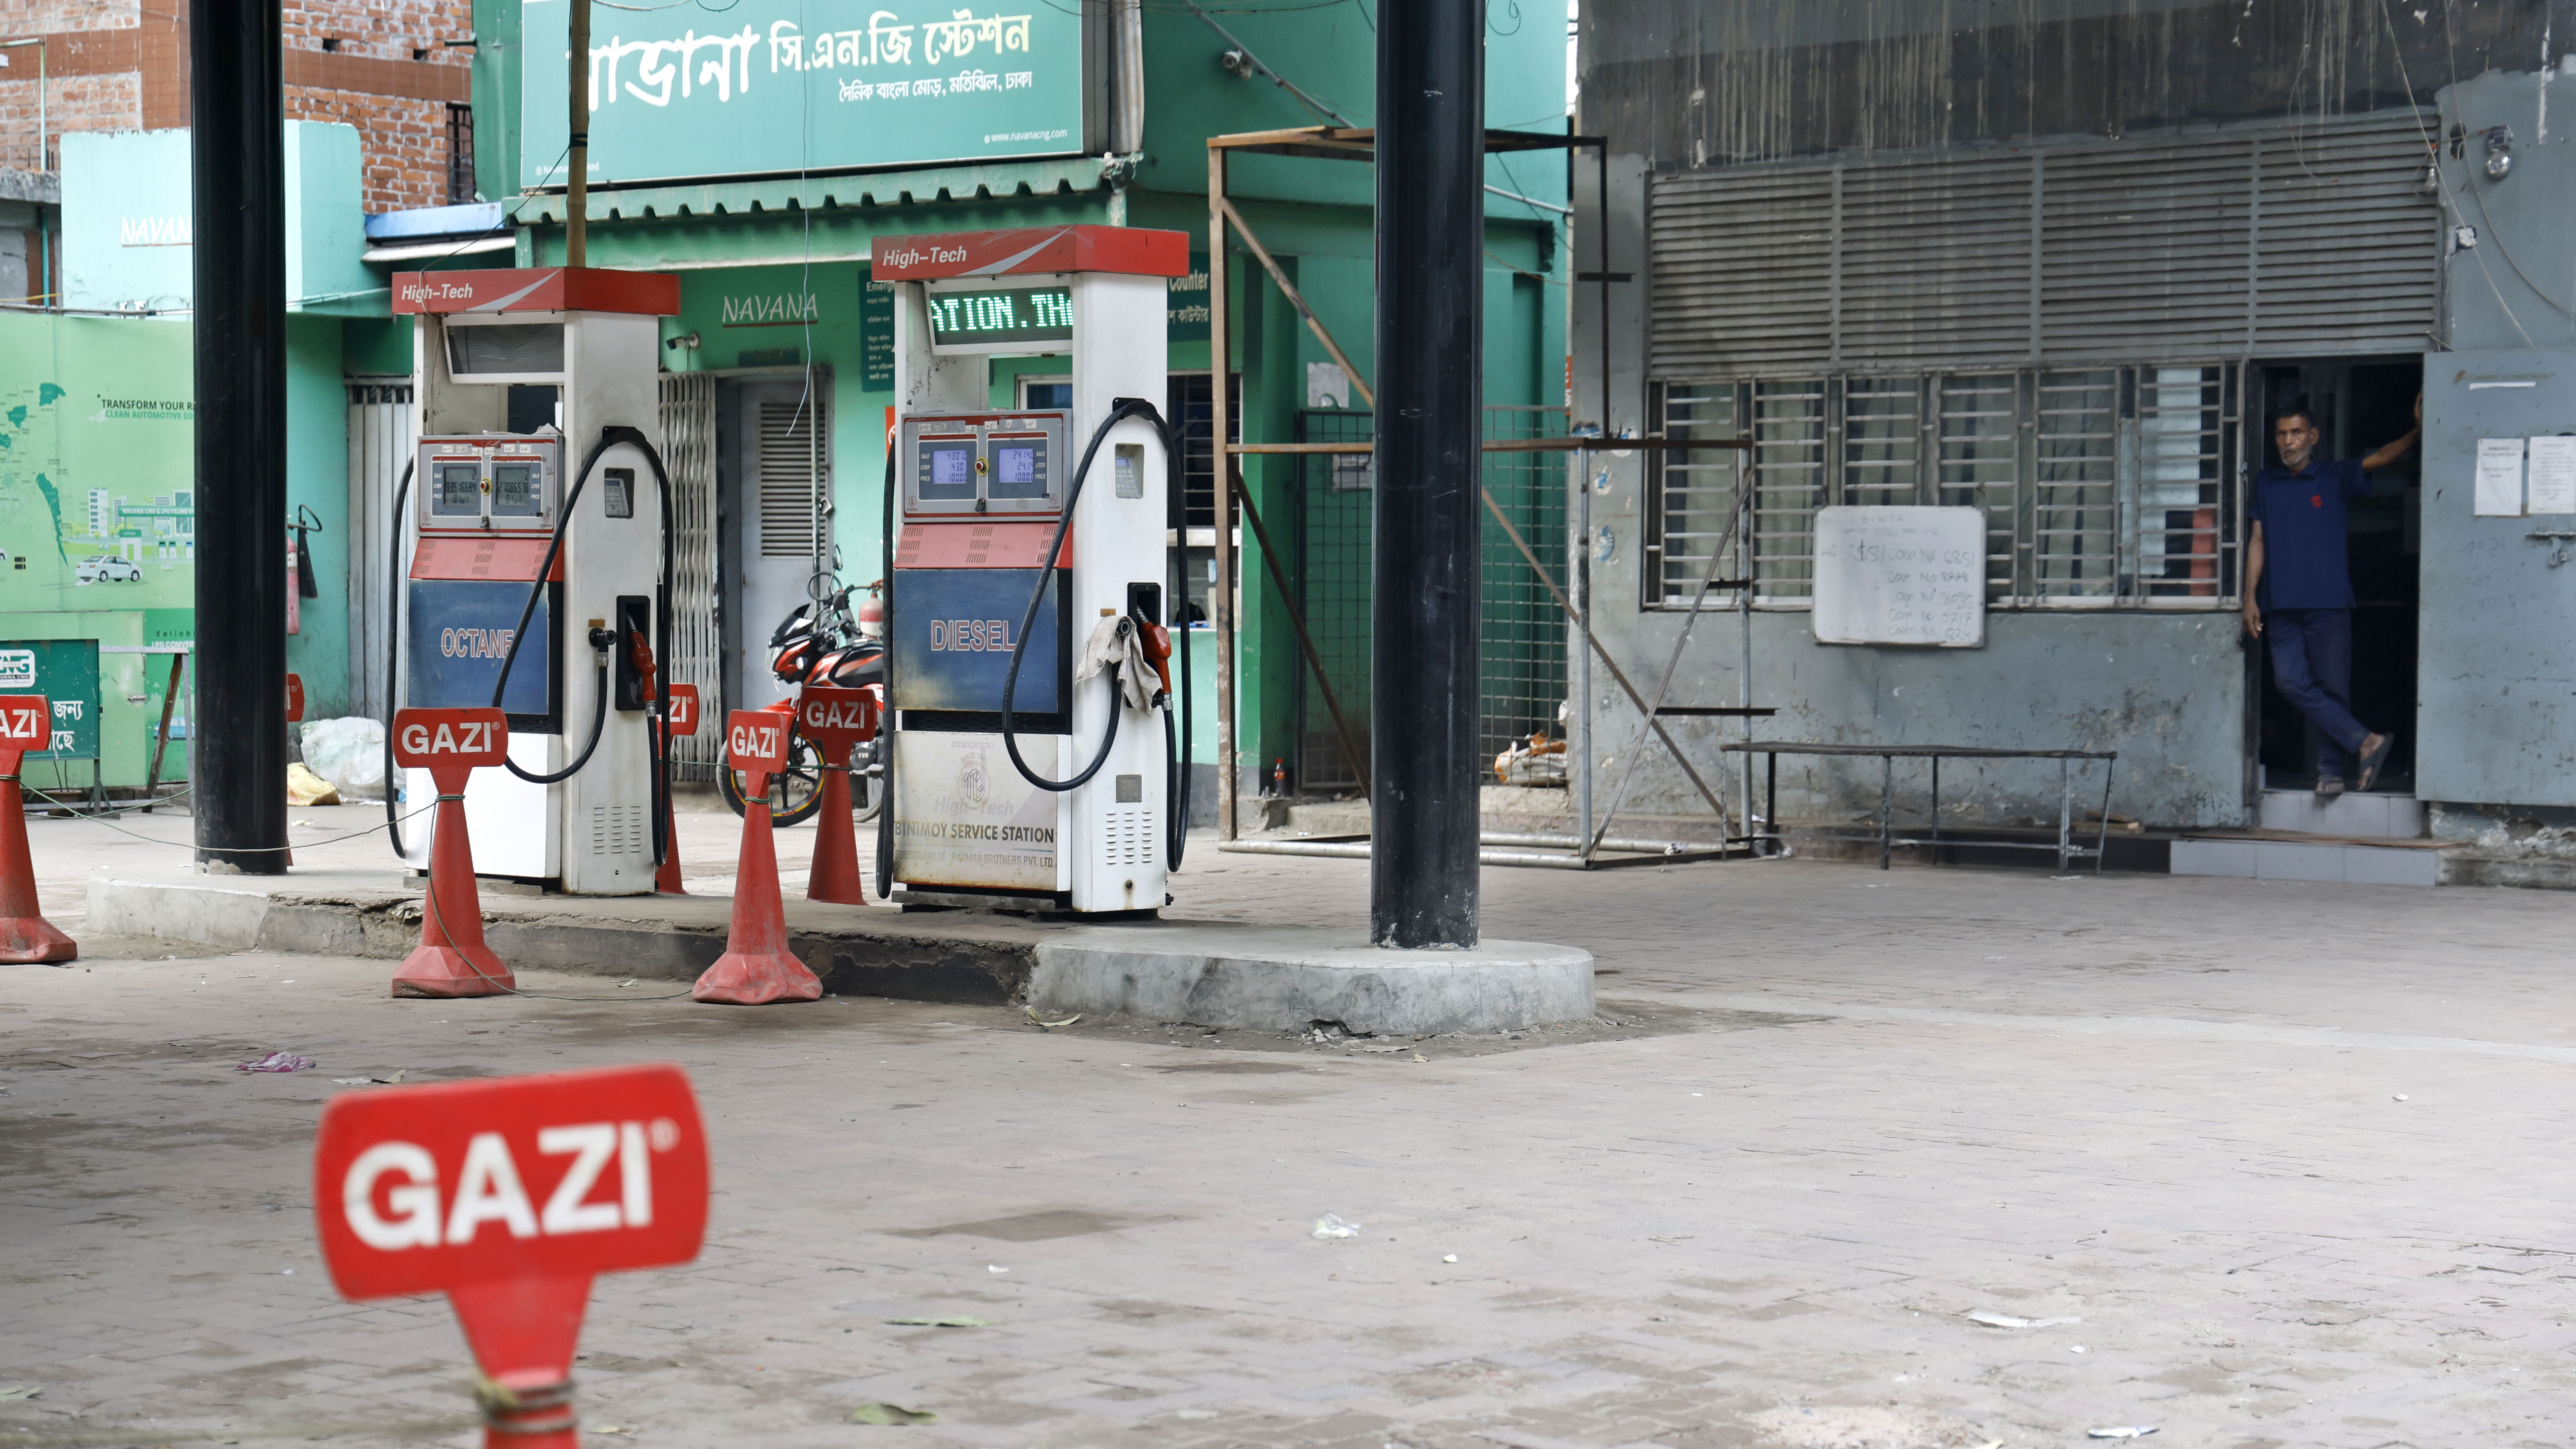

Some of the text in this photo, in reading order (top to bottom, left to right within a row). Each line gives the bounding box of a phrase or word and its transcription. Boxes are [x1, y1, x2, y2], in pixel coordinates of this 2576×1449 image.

[923, 9, 1032, 65] স্টেশন
[839, 78, 873, 102] দৈনিক
[876, 81, 909, 99] বাংলা
[1005, 71, 1033, 90] ঢাকা
[991, 130, 1067, 142] www.navanacng.com
[121, 216, 192, 243] NAVAN
[883, 246, 967, 268] High-Tech
[1169, 268, 1209, 292] Counter
[401, 283, 473, 302] High-Tech
[722, 292, 818, 323] NAVANA
[102, 399, 157, 409] TRANSFORM
[160, 401, 184, 410] YOUR
[132, 411, 181, 419] AUTOMOTIVE
[441, 628, 514, 658] OCTANE
[931, 620, 1016, 652] DIESEL
[0, 709, 36, 738] AZI
[894, 822, 1054, 843] BINIMOY SERVICE STATION
[895, 850, 936, 859] SUBSIDIARY
[952, 853, 982, 863] RAHMAN
[984, 854, 1021, 865] BROTHERS
[1024, 856, 1038, 866] PVT.
[1040, 857, 1054, 867] LTD.
